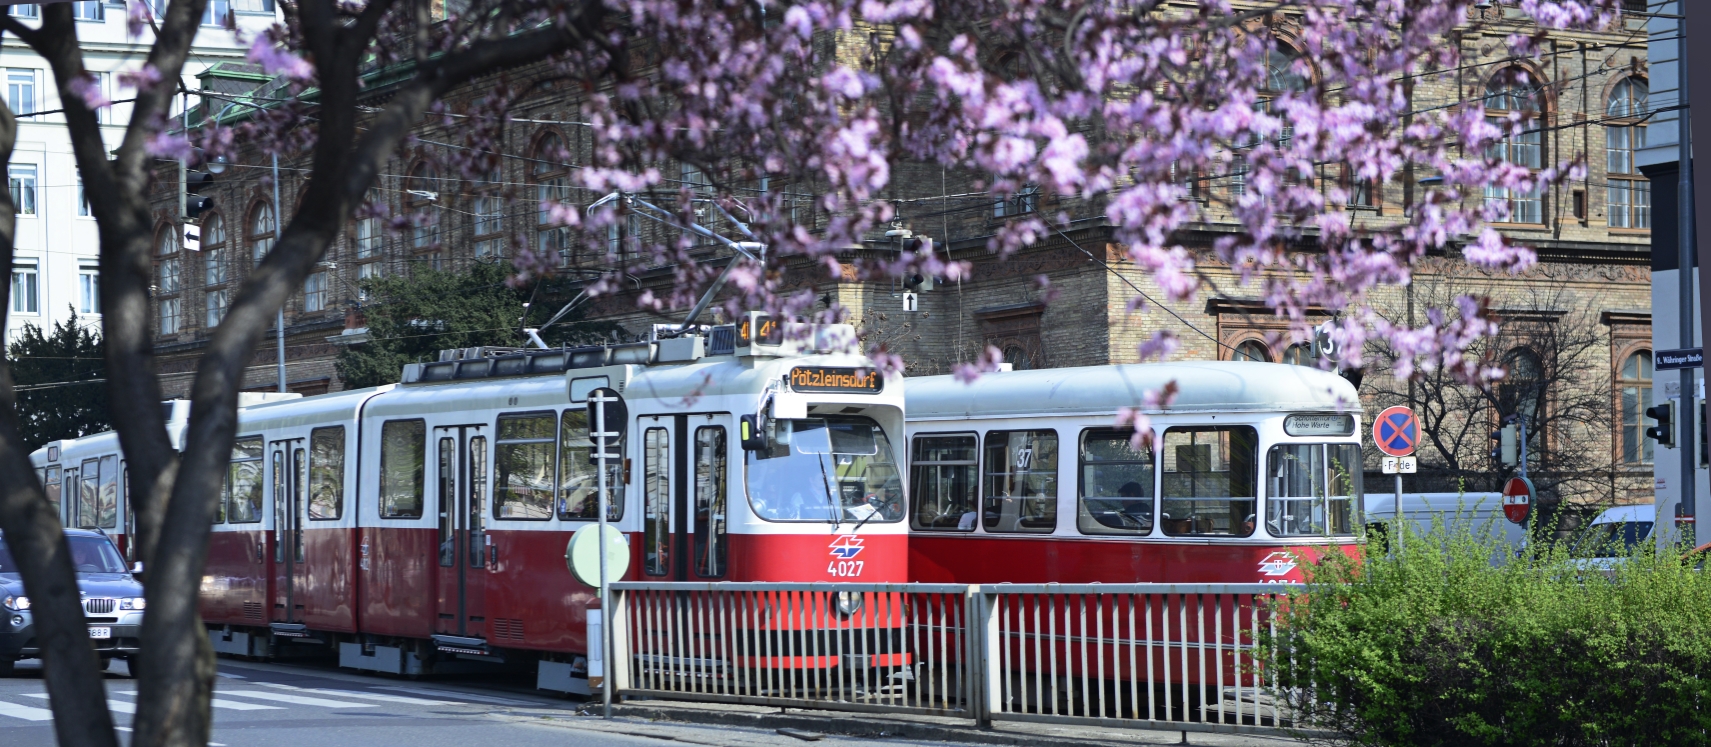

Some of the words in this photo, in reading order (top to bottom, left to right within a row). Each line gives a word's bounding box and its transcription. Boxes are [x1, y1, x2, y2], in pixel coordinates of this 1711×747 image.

[1687, 353, 1702, 362] Straße
[792, 368, 876, 388] Pötzleinsdorf
[1017, 449, 1031, 467] 37
[827, 560, 864, 577] 4027
